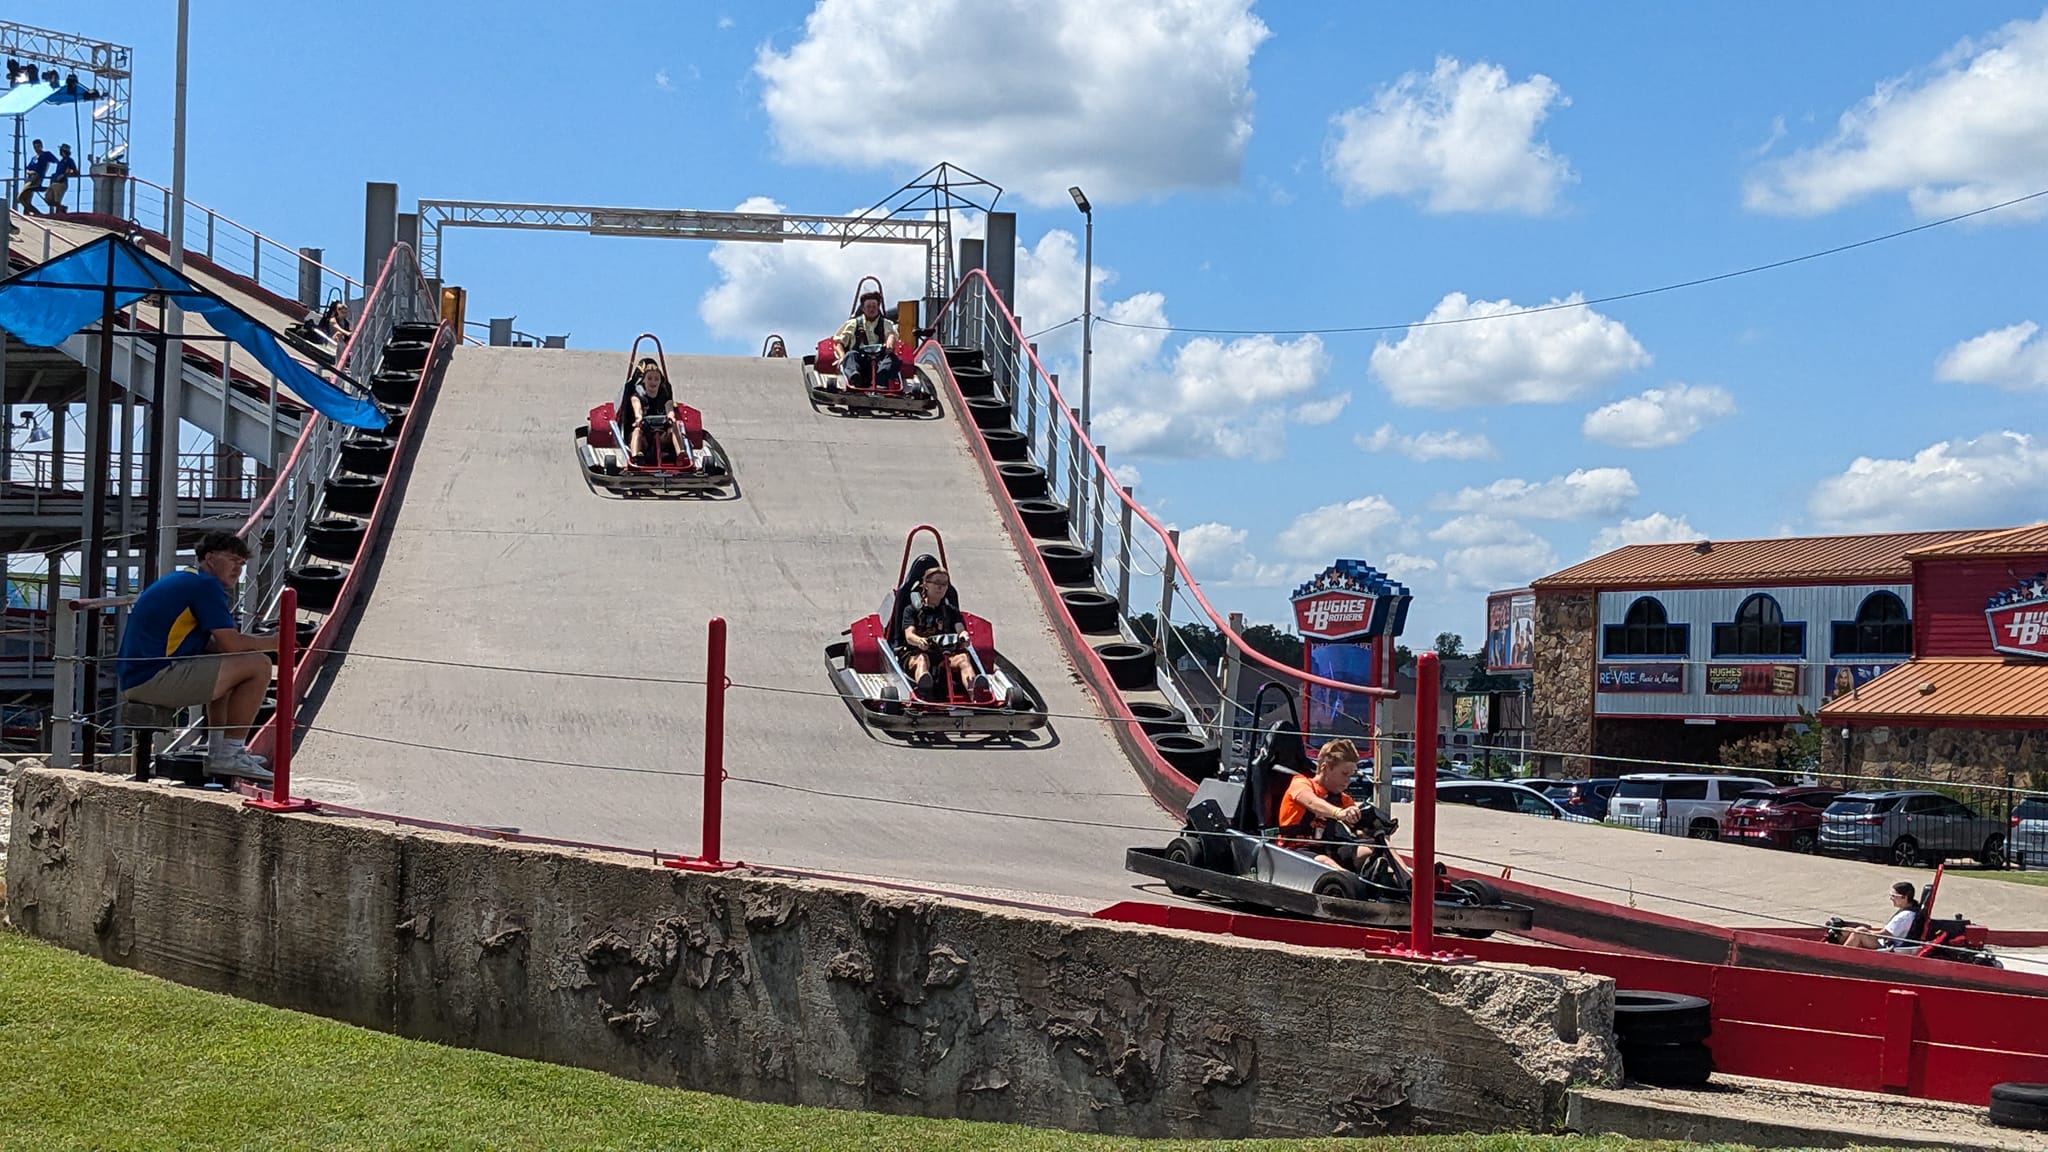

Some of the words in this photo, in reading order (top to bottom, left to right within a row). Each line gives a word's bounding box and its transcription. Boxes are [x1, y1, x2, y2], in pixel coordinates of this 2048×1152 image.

[1304, 600, 1366, 624] HUGHES
[1314, 612, 1363, 631] BROTHERS
[1600, 670, 1635, 685] RE-VIBE
[1709, 667, 1742, 677] HUGHES
